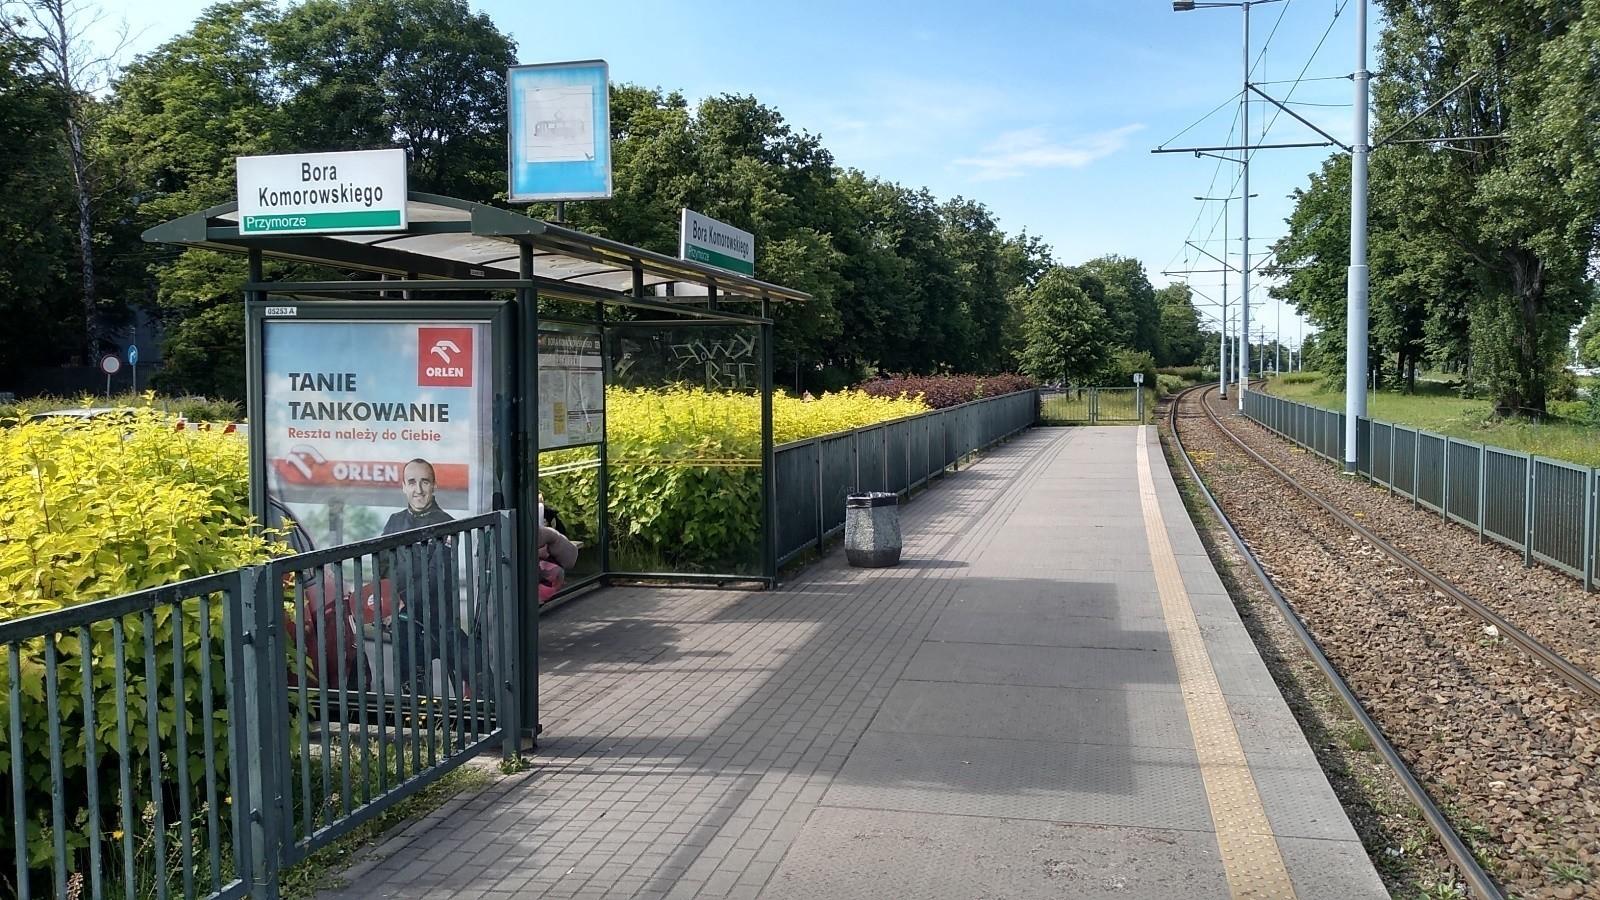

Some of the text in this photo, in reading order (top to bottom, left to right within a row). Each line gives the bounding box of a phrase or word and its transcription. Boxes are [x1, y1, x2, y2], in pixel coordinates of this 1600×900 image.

[301, 162, 337, 182] Bora
[258, 183, 383, 207] Komorowskiego
[246, 216, 307, 231] Przymorze
[692, 220, 749, 259] Bora Komorowskiego
[289, 307, 295, 315] A
[288, 372, 357, 392] TANIE
[426, 367, 464, 378] ORLEN
[288, 401, 449, 423] TANKOWANIE
[288, 427, 441, 443] Reszta należy do Ciebie
[333, 463, 400, 483] ORLEN
